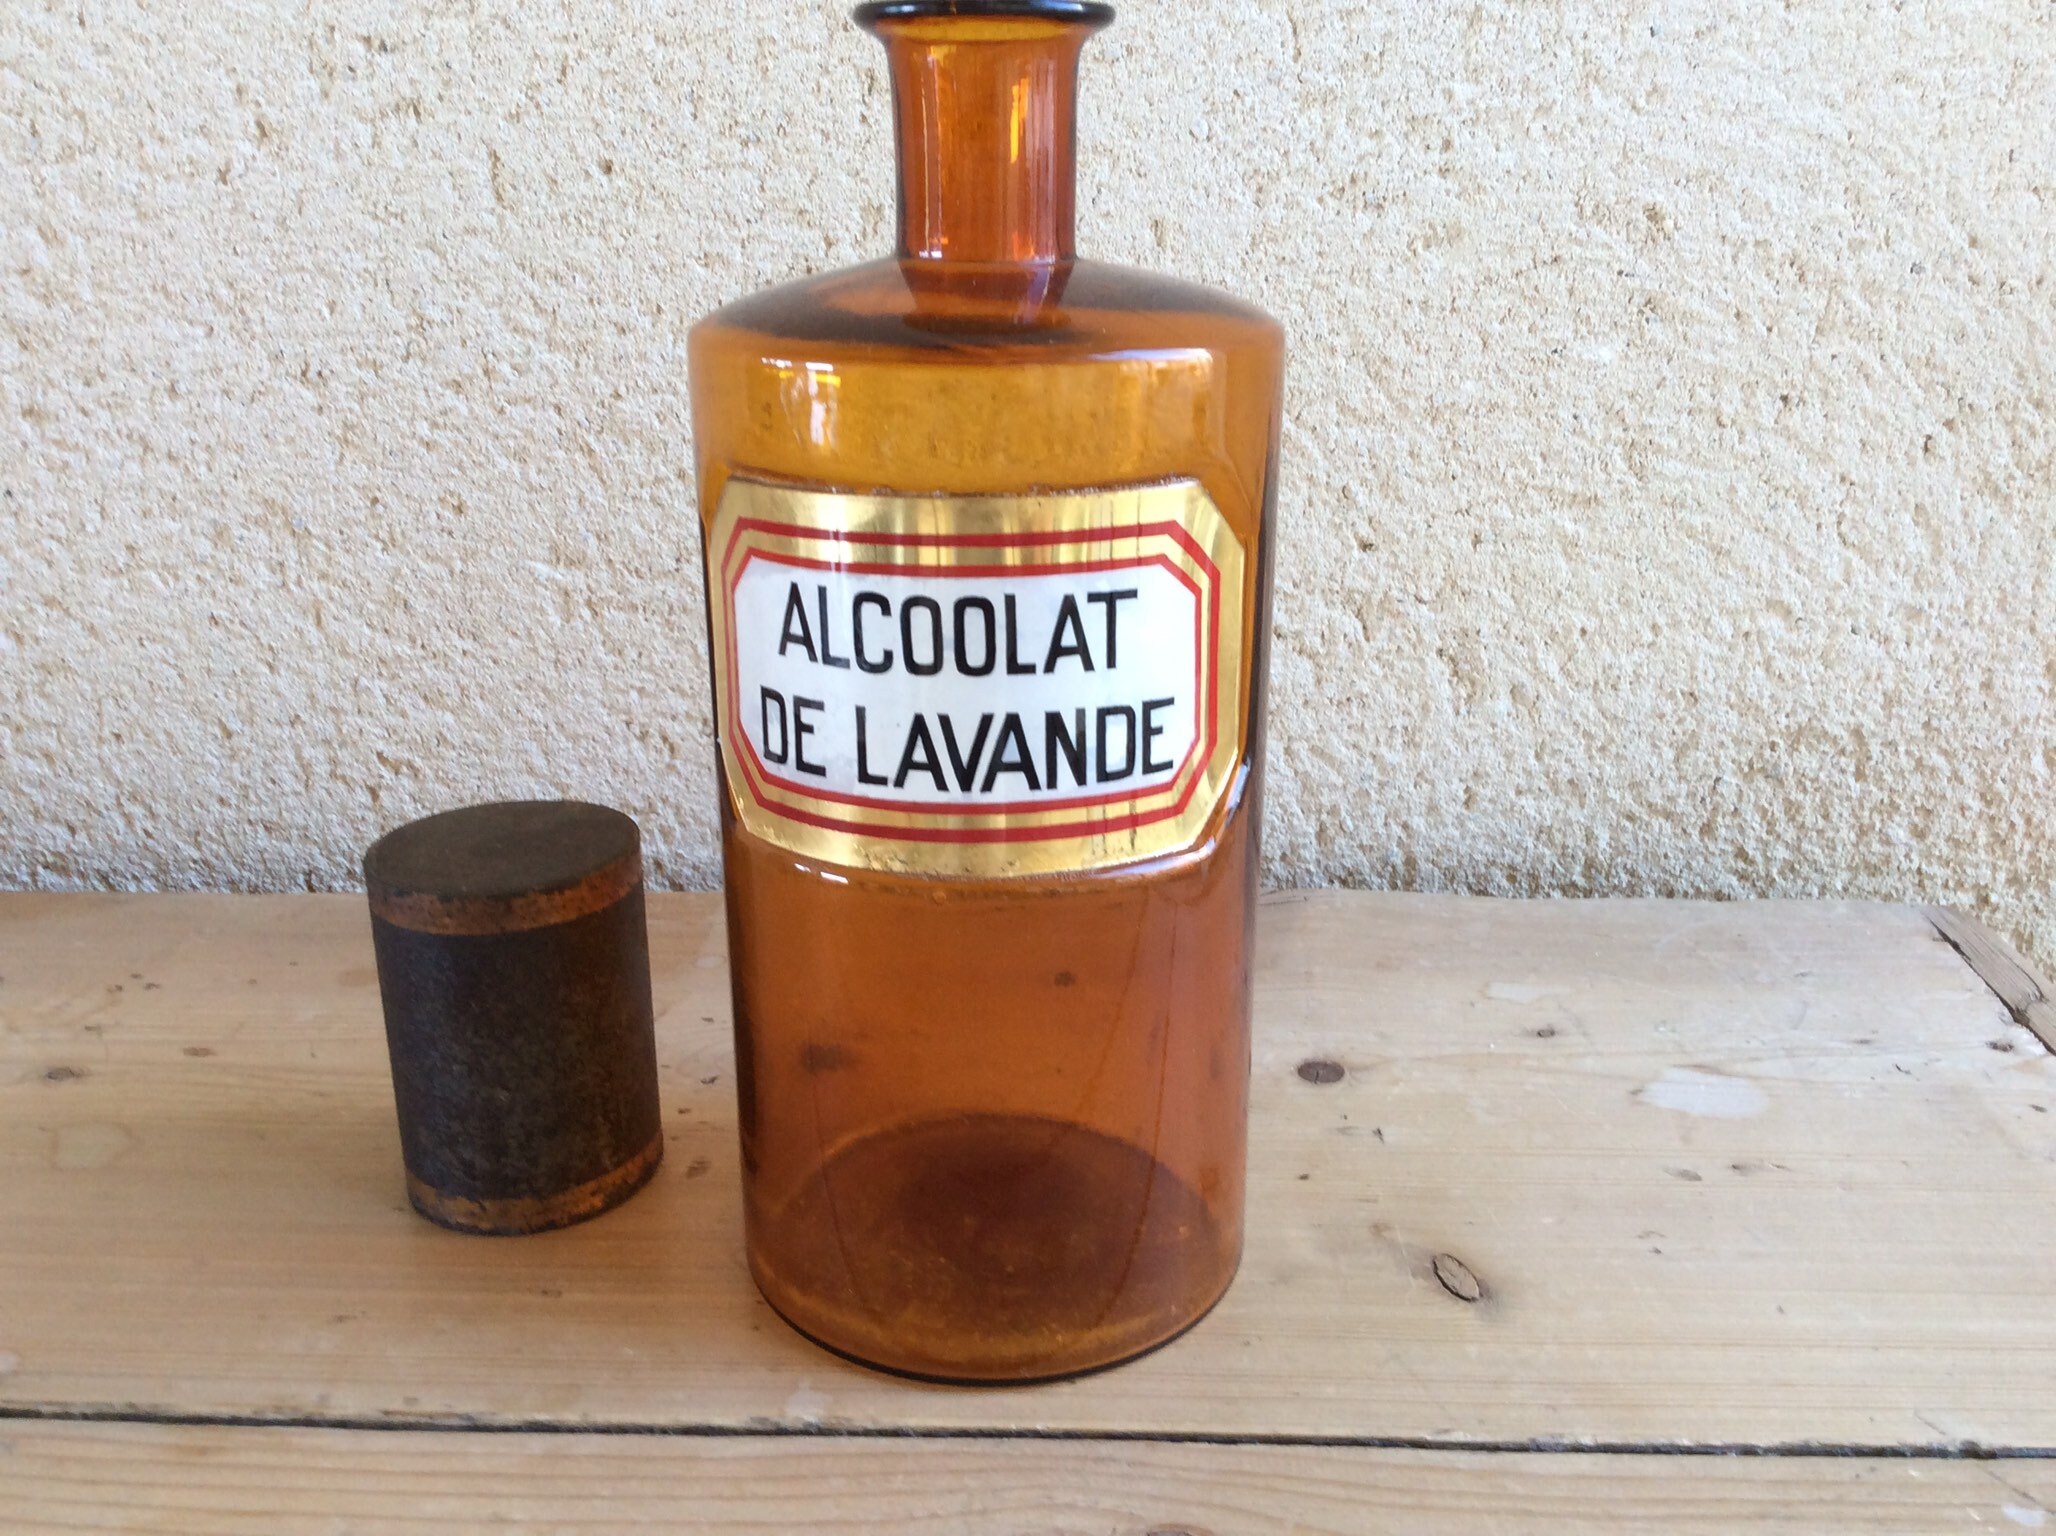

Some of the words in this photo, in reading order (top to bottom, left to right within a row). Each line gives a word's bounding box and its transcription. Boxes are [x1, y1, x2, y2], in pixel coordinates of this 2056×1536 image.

[778, 581, 1138, 677] ALCOOLAT
[760, 685, 827, 778] DE
[855, 696, 1176, 793] LAVANDE
